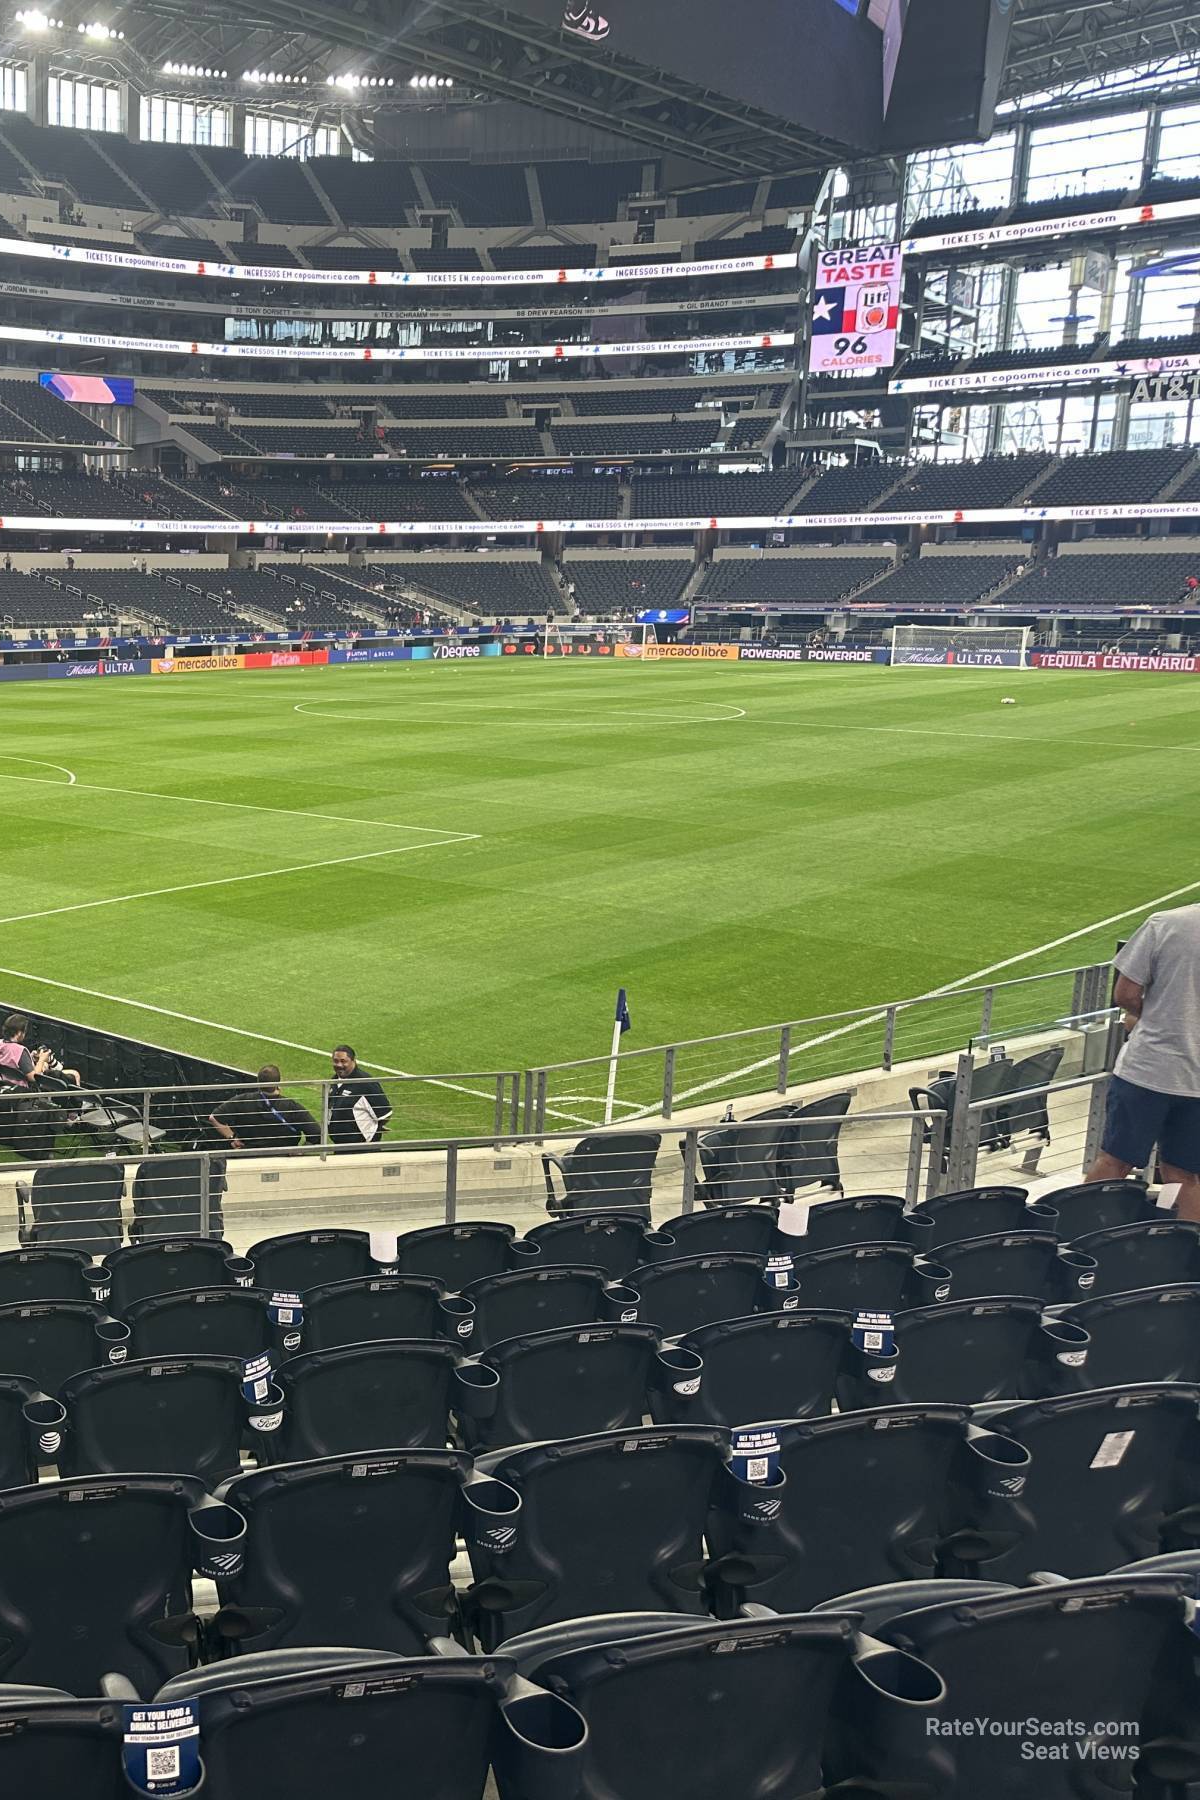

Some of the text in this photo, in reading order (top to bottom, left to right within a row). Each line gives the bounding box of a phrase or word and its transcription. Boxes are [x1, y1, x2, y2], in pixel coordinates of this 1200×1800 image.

[942, 216, 1116, 245] TICKETS AT copaamerica.com
[822, 244, 900, 266] GREAT
[616, 267, 658, 276] INGRESSOS
[822, 262, 895, 283] TASTE
[864, 291, 888, 307] Lite
[834, 336, 867, 356] 96
[822, 354, 882, 366] CALORIES
[1166, 359, 1189, 368] USA
[929, 377, 970, 388] TICKETS
[975, 376, 987, 384] AT
[441, 645, 480, 659] Degree
[646, 645, 728, 659] mercado libre
[740, 649, 800, 660] POWERADE
[808, 650, 872, 662] POWERADE
[956, 653, 1003, 664] ULTRA
[105, 663, 135, 674] ULTRA
[178, 656, 238, 670] mercado libre
[1040, 654, 1196, 671] TEQUILA CENTENARIO
[133, 1707, 190, 1721] GET YOUR FOOD &
[130, 1715, 194, 1731] DRINKS DELIVERED!
